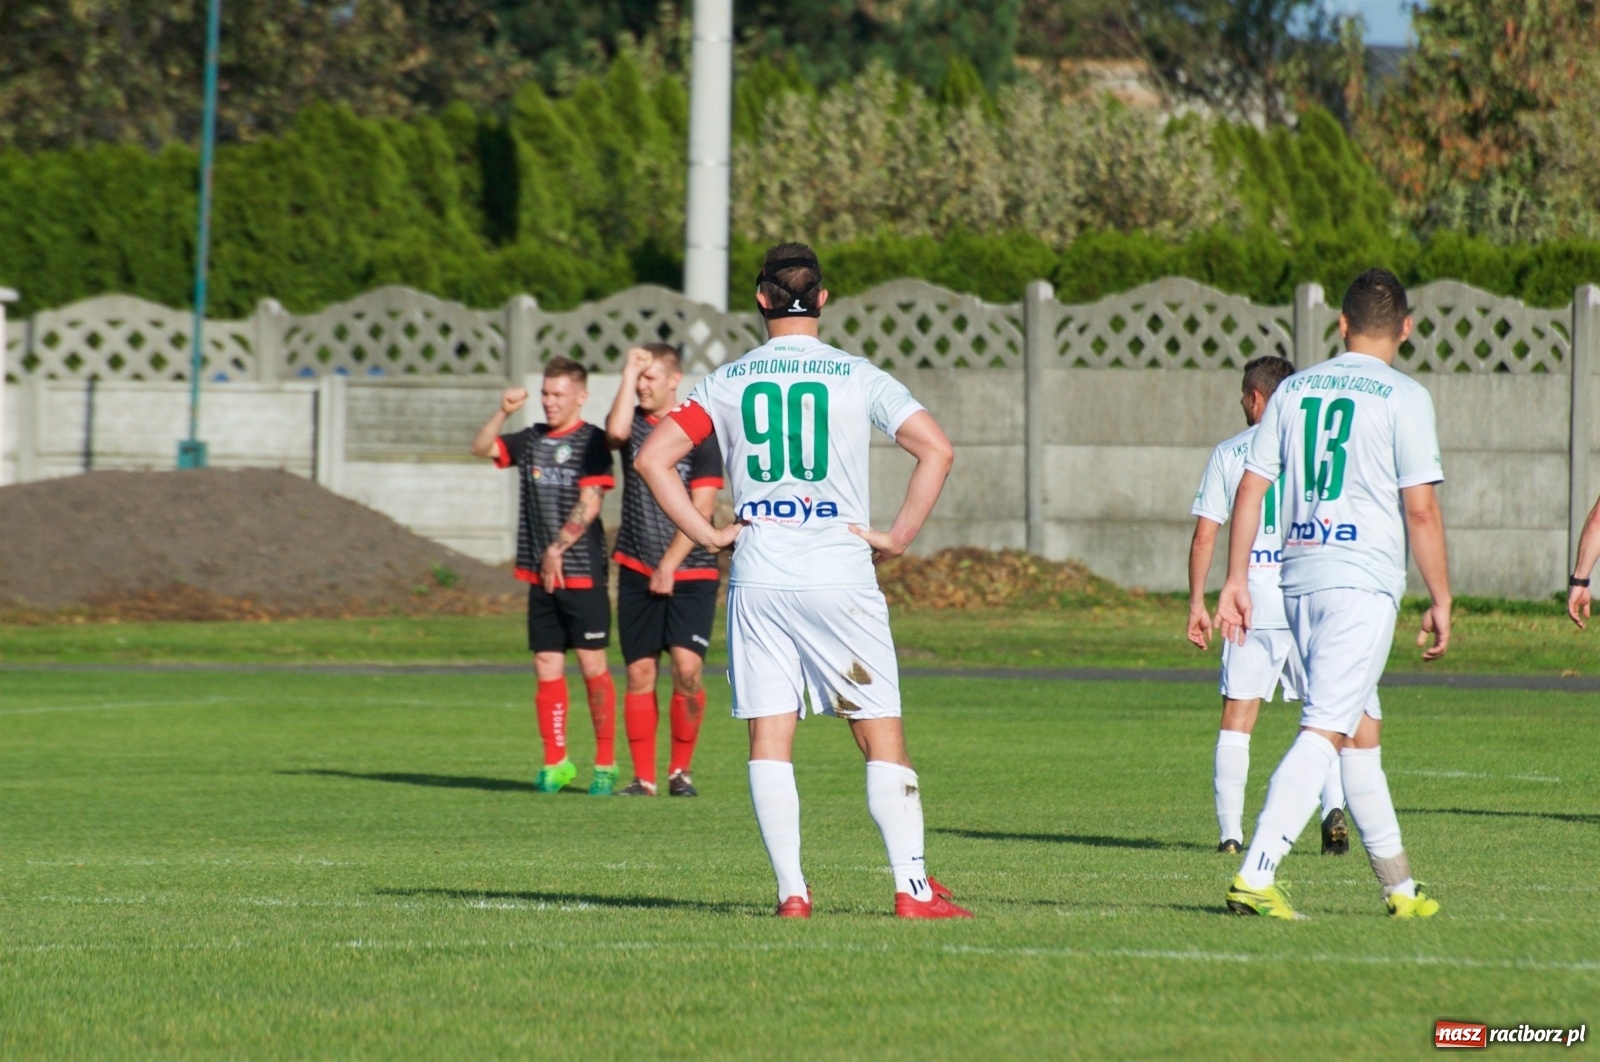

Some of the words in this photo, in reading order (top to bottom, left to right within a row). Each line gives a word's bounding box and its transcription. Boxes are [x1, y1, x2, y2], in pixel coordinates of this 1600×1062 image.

[726, 362, 747, 379] LKS
[749, 359, 800, 376] POLONIA
[803, 360, 851, 376] ŁAZISKA
[1285, 375, 1304, 393] LKS
[1306, 374, 1349, 389] POLONIA
[1350, 374, 1393, 399] ŁAZISKA
[741, 381, 829, 483] 90
[1300, 397, 1355, 502] 13
[738, 493, 839, 528] moya
[1288, 515, 1357, 546] moya
